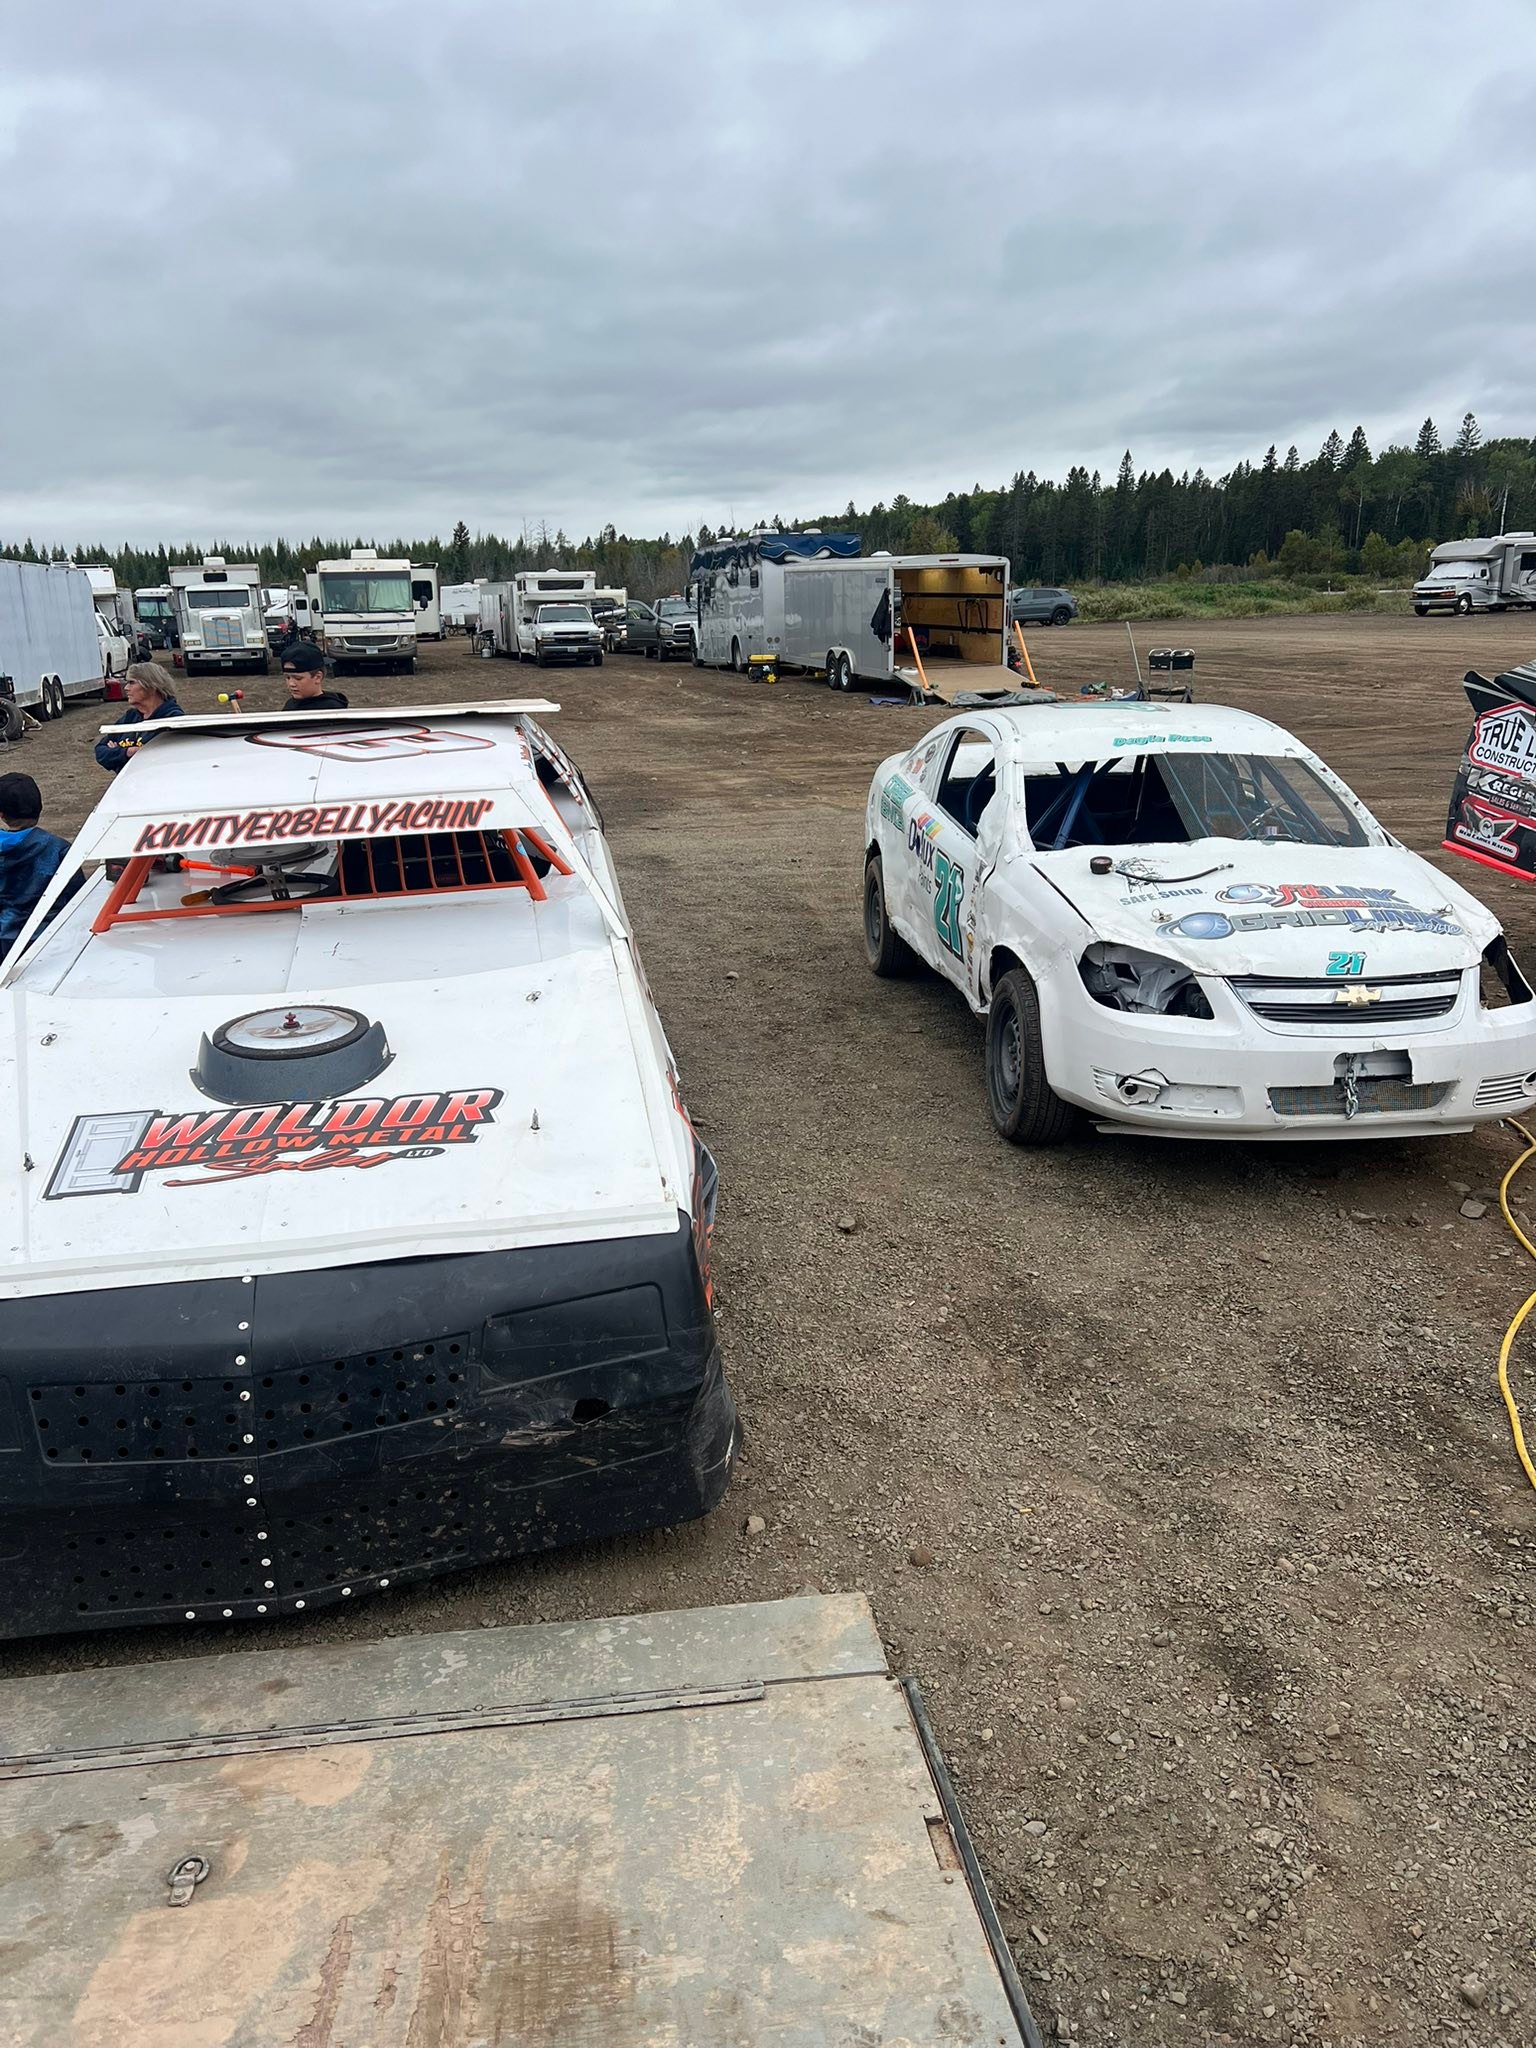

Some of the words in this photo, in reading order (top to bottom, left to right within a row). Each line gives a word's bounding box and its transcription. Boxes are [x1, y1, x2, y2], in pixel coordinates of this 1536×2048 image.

[1482, 716, 1526, 753] TRUE
[134, 799, 493, 853] KWITYERBELLYACHIN'
[1229, 909, 1452, 933] GRIDLINK
[142, 1089, 494, 1150] WOLDOR
[119, 1134, 319, 1171] HOLLOW
[329, 1123, 468, 1145] METAL
[405, 1148, 435, 1158] LTD
